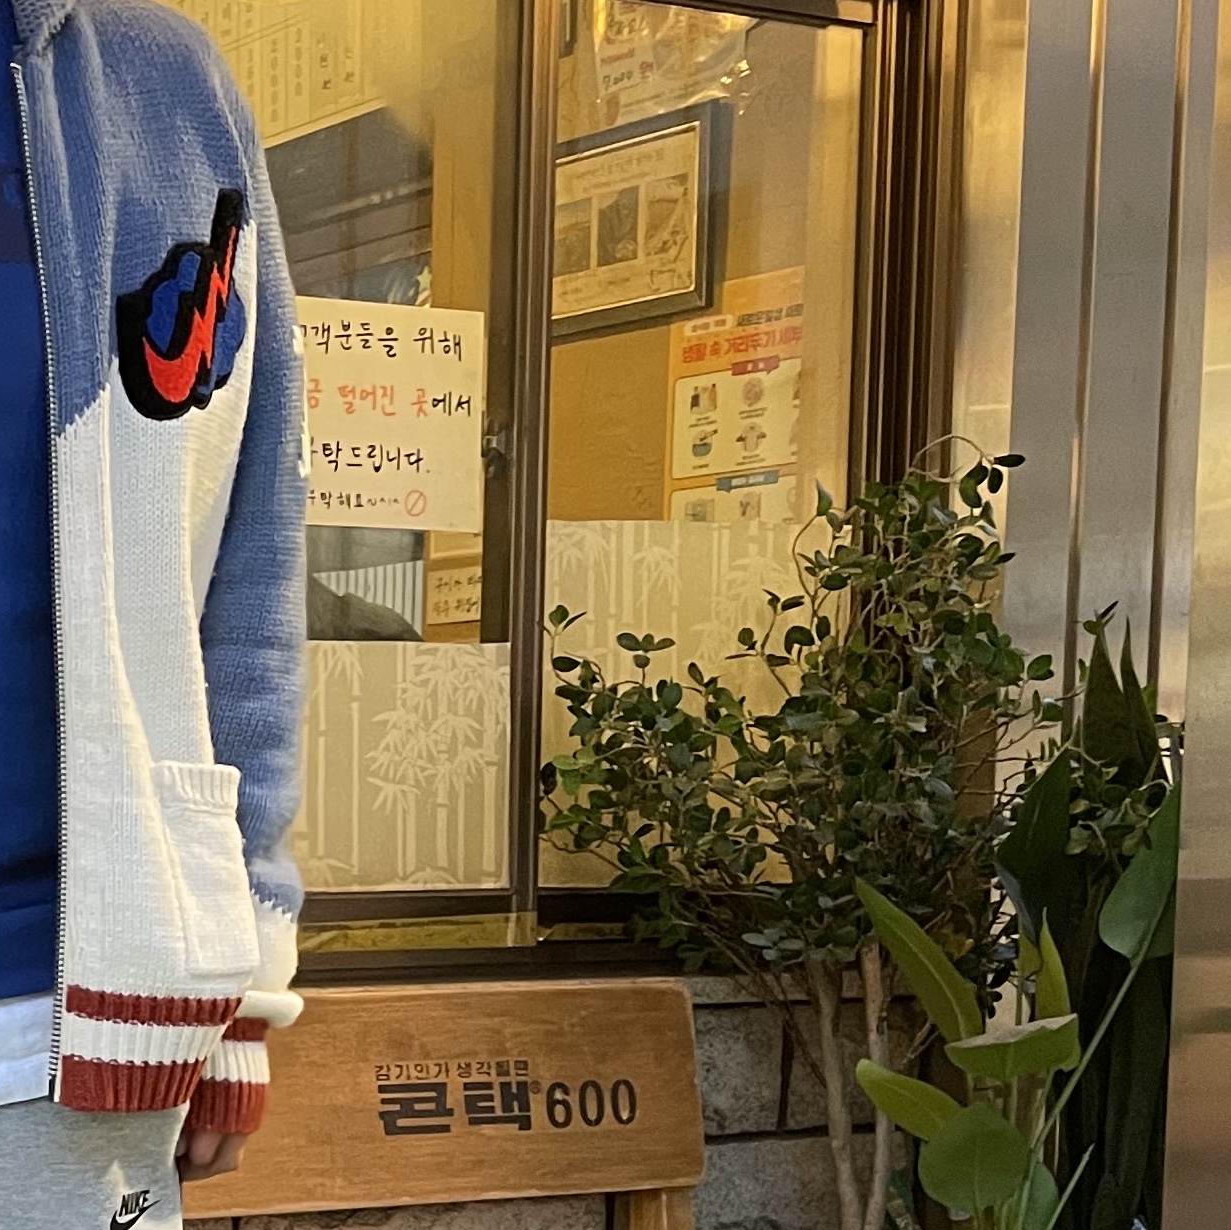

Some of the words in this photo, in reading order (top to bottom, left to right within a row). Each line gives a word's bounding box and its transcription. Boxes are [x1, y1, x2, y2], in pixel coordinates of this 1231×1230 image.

[413, 326, 462, 361] 위해
[337, 384, 396, 416] 떨어진
[411, 388, 472, 418] 곳에서
[374, 1061, 450, 1082] 감기인가
[546, 1078, 637, 1129] 600
[118, 1189, 150, 1218] NIKE
